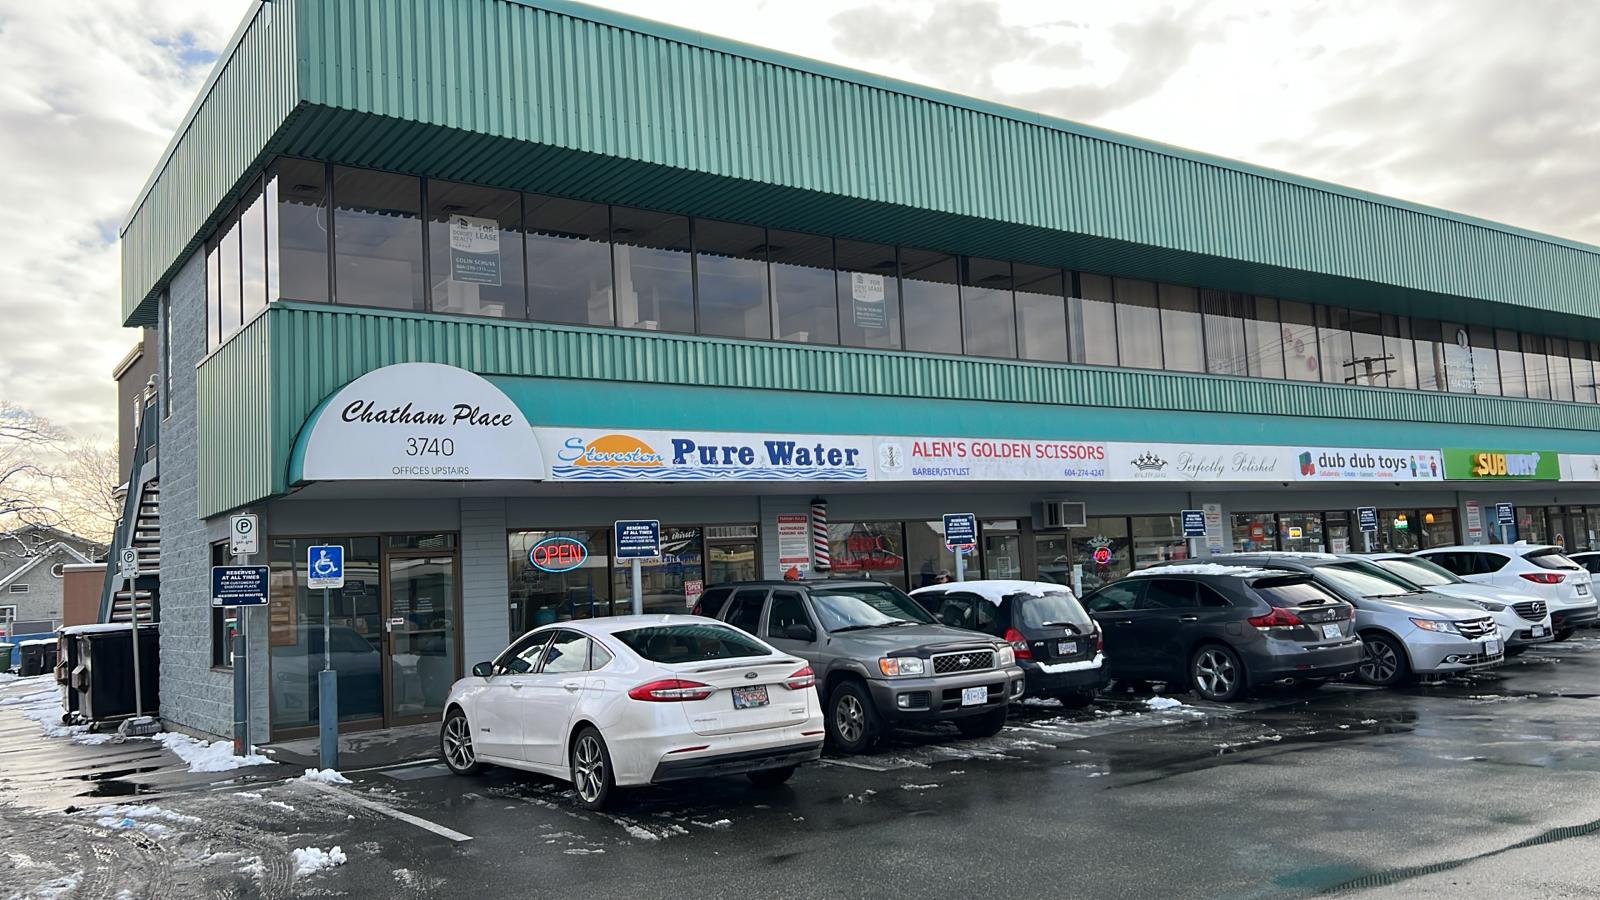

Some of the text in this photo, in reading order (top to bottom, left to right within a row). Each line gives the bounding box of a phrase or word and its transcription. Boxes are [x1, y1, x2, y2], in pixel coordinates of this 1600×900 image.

[475, 232, 497, 240] LEASE
[341, 399, 513, 427] Chatham Place
[406, 437, 454, 456] 3740
[557, 436, 859, 467] Steveston Pure Water
[912, 441, 1105, 460] ALEN'S GOLDEN SCISSORS
[392, 466, 469, 475] OFFICES UPSTAIRS
[912, 467, 970, 476] BARBER/STYLIST
[1176, 451, 1278, 478] Perfectly Polished
[1318, 452, 1408, 473] dub dub toys
[1476, 452, 1541, 477] SUBWAY
[240, 521, 249, 531] P
[533, 544, 582, 567] OPEN
